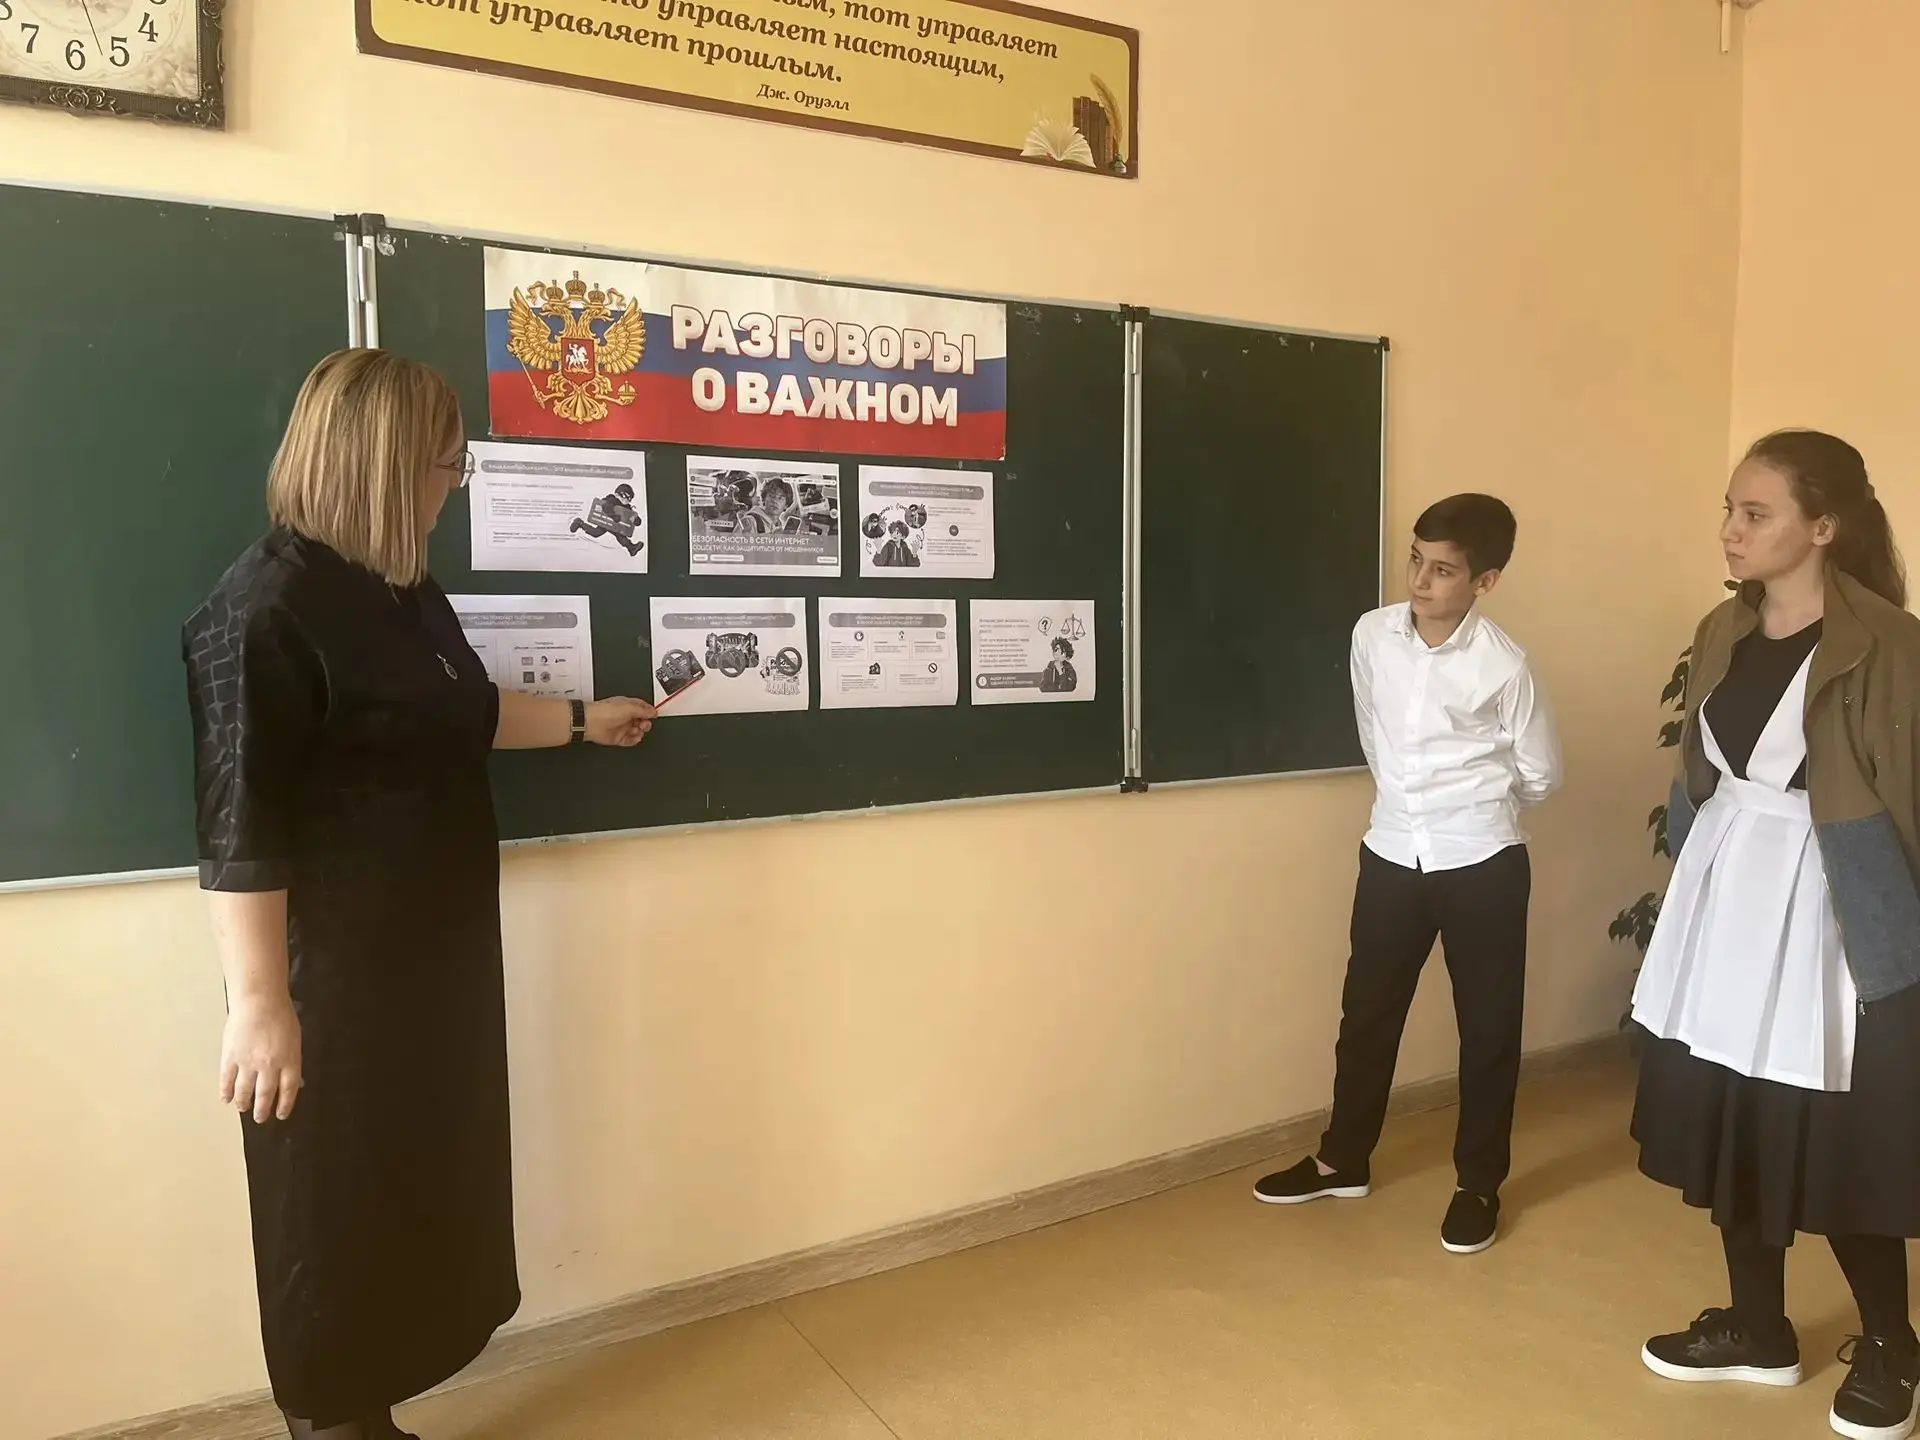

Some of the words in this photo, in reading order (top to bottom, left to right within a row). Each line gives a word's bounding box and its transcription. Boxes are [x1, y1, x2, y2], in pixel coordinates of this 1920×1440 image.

[20, 22, 40, 54] 7
[137, 11, 159, 42] 4
[488, 0, 680, 52] управляет
[686, 38, 842, 83] прошлым.
[657, 0, 827, 46] управляет
[834, 32, 1005, 84] настоящим,
[843, 0, 910, 29] тот
[916, 16, 1058, 59] управляет
[65, 39, 86, 71] 6
[109, 36, 130, 67] 5
[756, 83, 790, 101] Дж.
[794, 90, 850, 111] Оруэлл
[671, 304, 976, 375] РАЗГОВОРЫ
[691, 366, 727, 412] О
[736, 371, 959, 427] ВАЖНОМ
